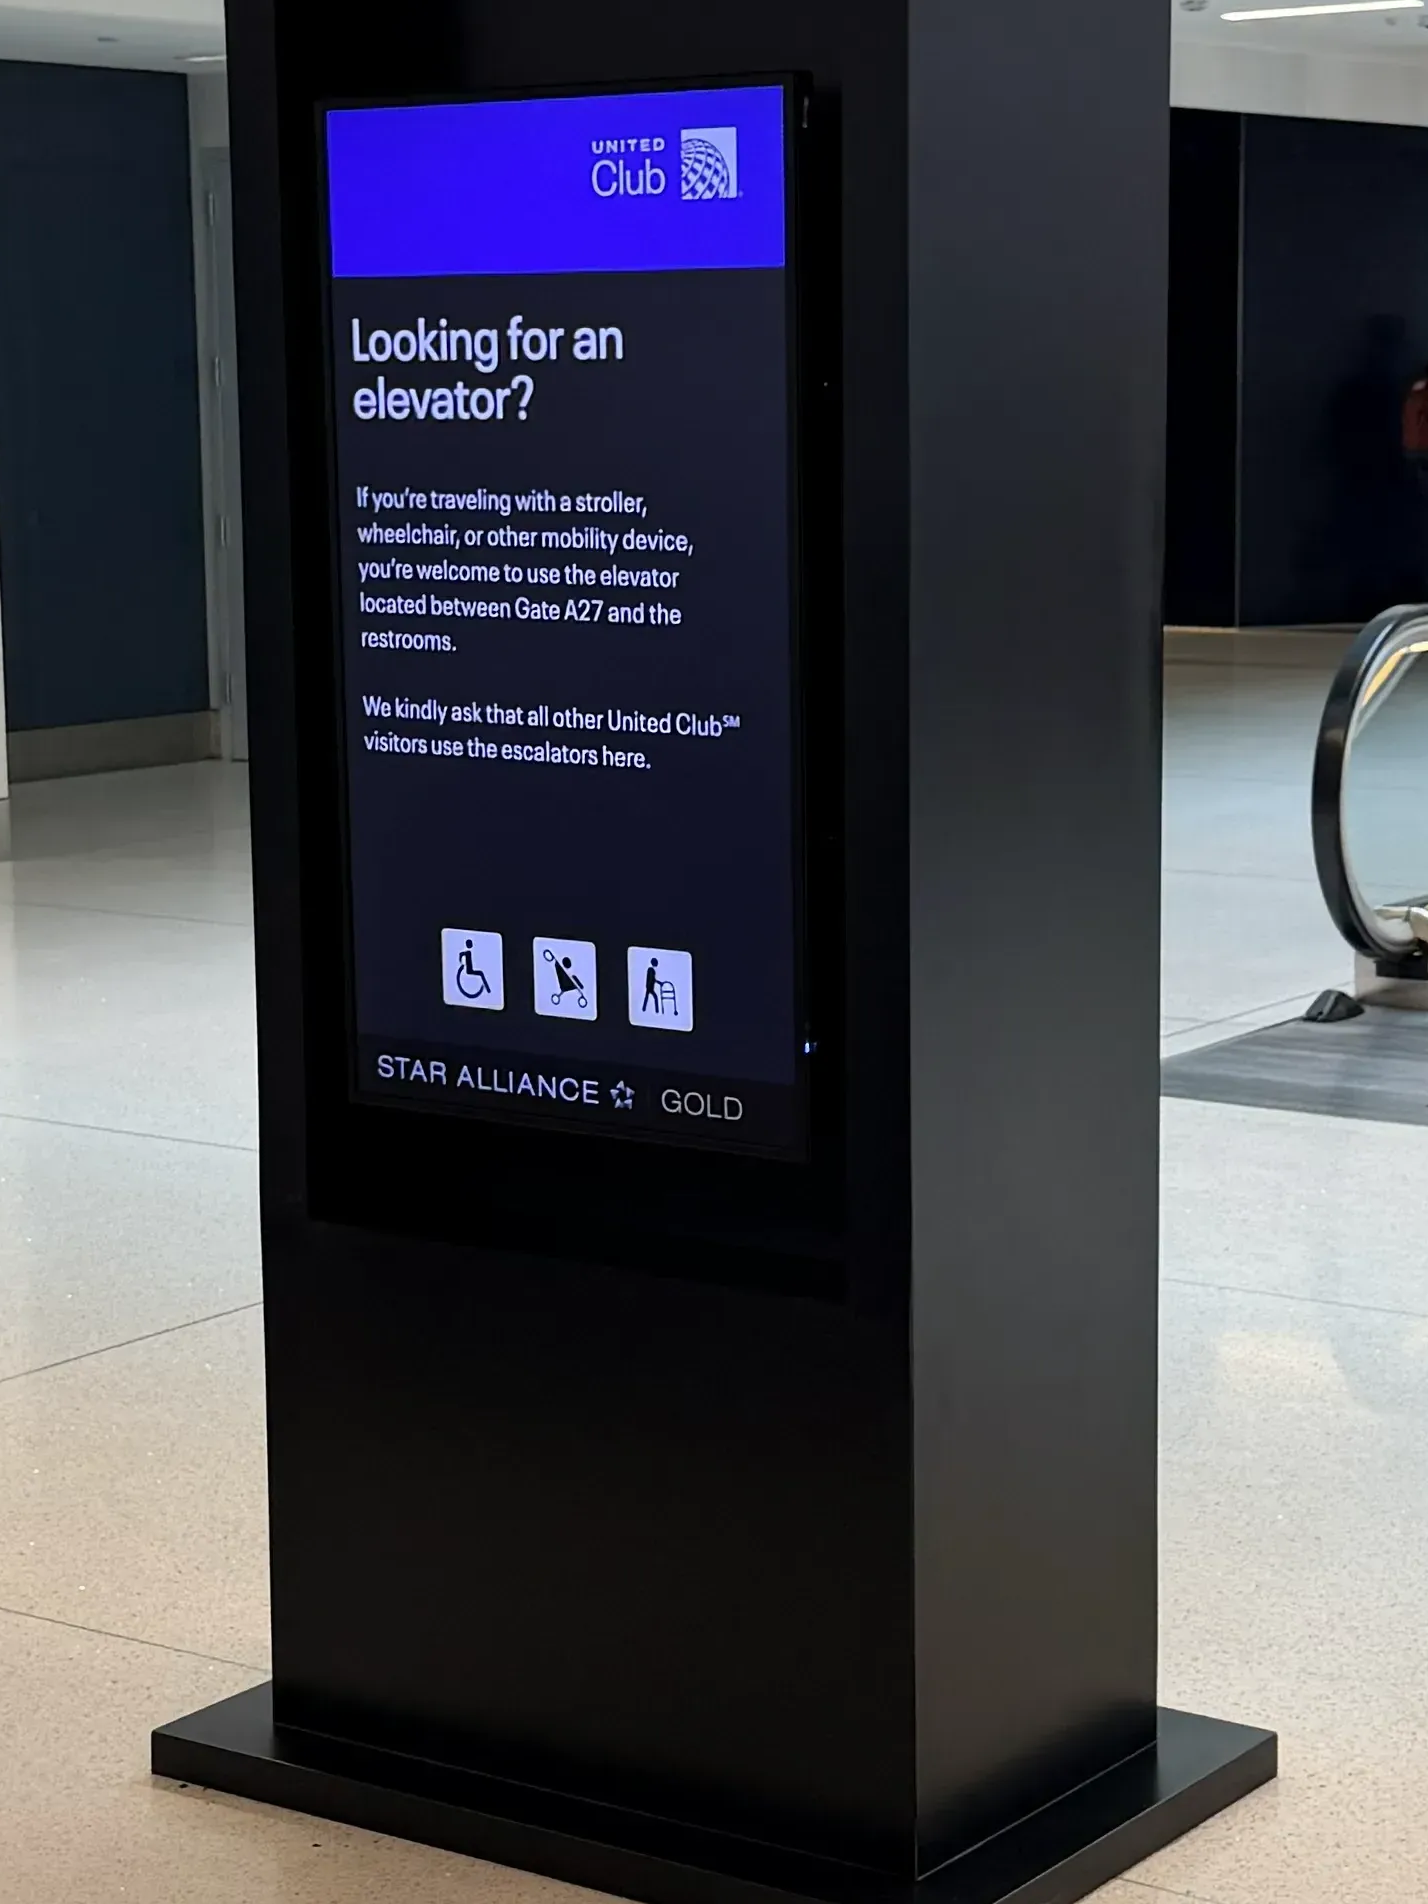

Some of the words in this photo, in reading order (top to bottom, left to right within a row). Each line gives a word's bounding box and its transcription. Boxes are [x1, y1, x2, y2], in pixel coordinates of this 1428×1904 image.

[592, 138, 665, 154] UNITED
[592, 159, 665, 196] Club
[352, 318, 498, 373] Looking
[507, 315, 564, 360] for
[573, 327, 623, 360] an
[354, 375, 533, 420] elevator?
[357, 486, 368, 507] If
[372, 487, 427, 513] you're
[430, 489, 511, 516] traveling
[515, 490, 556, 511] with
[560, 496, 571, 511] a
[576, 491, 646, 518] stroller,
[357, 522, 460, 549] wheelchair,
[464, 530, 484, 545] or
[488, 525, 538, 547] other
[542, 527, 619, 555] mobility
[623, 528, 693, 556] device,
[358, 558, 413, 583] you're
[416, 559, 500, 582] welcome
[504, 564, 523, 582] to
[527, 568, 560, 584] use
[564, 564, 596, 585] the
[600, 565, 679, 587] elevator
[360, 592, 426, 614] located
[431, 595, 511, 618] between
[515, 597, 560, 620] Gate
[564, 599, 603, 621] A27
[608, 602, 644, 623] and
[649, 603, 681, 625] the
[362, 631, 456, 651] restrooms.
[363, 696, 391, 717] We
[395, 697, 447, 725] kindly
[451, 702, 482, 723] ask
[486, 703, 524, 725] that
[528, 705, 548, 726] all
[553, 707, 603, 729] other
[608, 710, 671, 733] United
[364, 731, 427, 754] visitors
[431, 740, 463, 756] use
[467, 737, 497, 758] the
[501, 741, 598, 765] escalators
[603, 745, 651, 769] here.
[378, 1055, 446, 1085] STAR
[457, 1065, 599, 1104] ALLIANCE
[662, 1089, 742, 1120] GOLD
